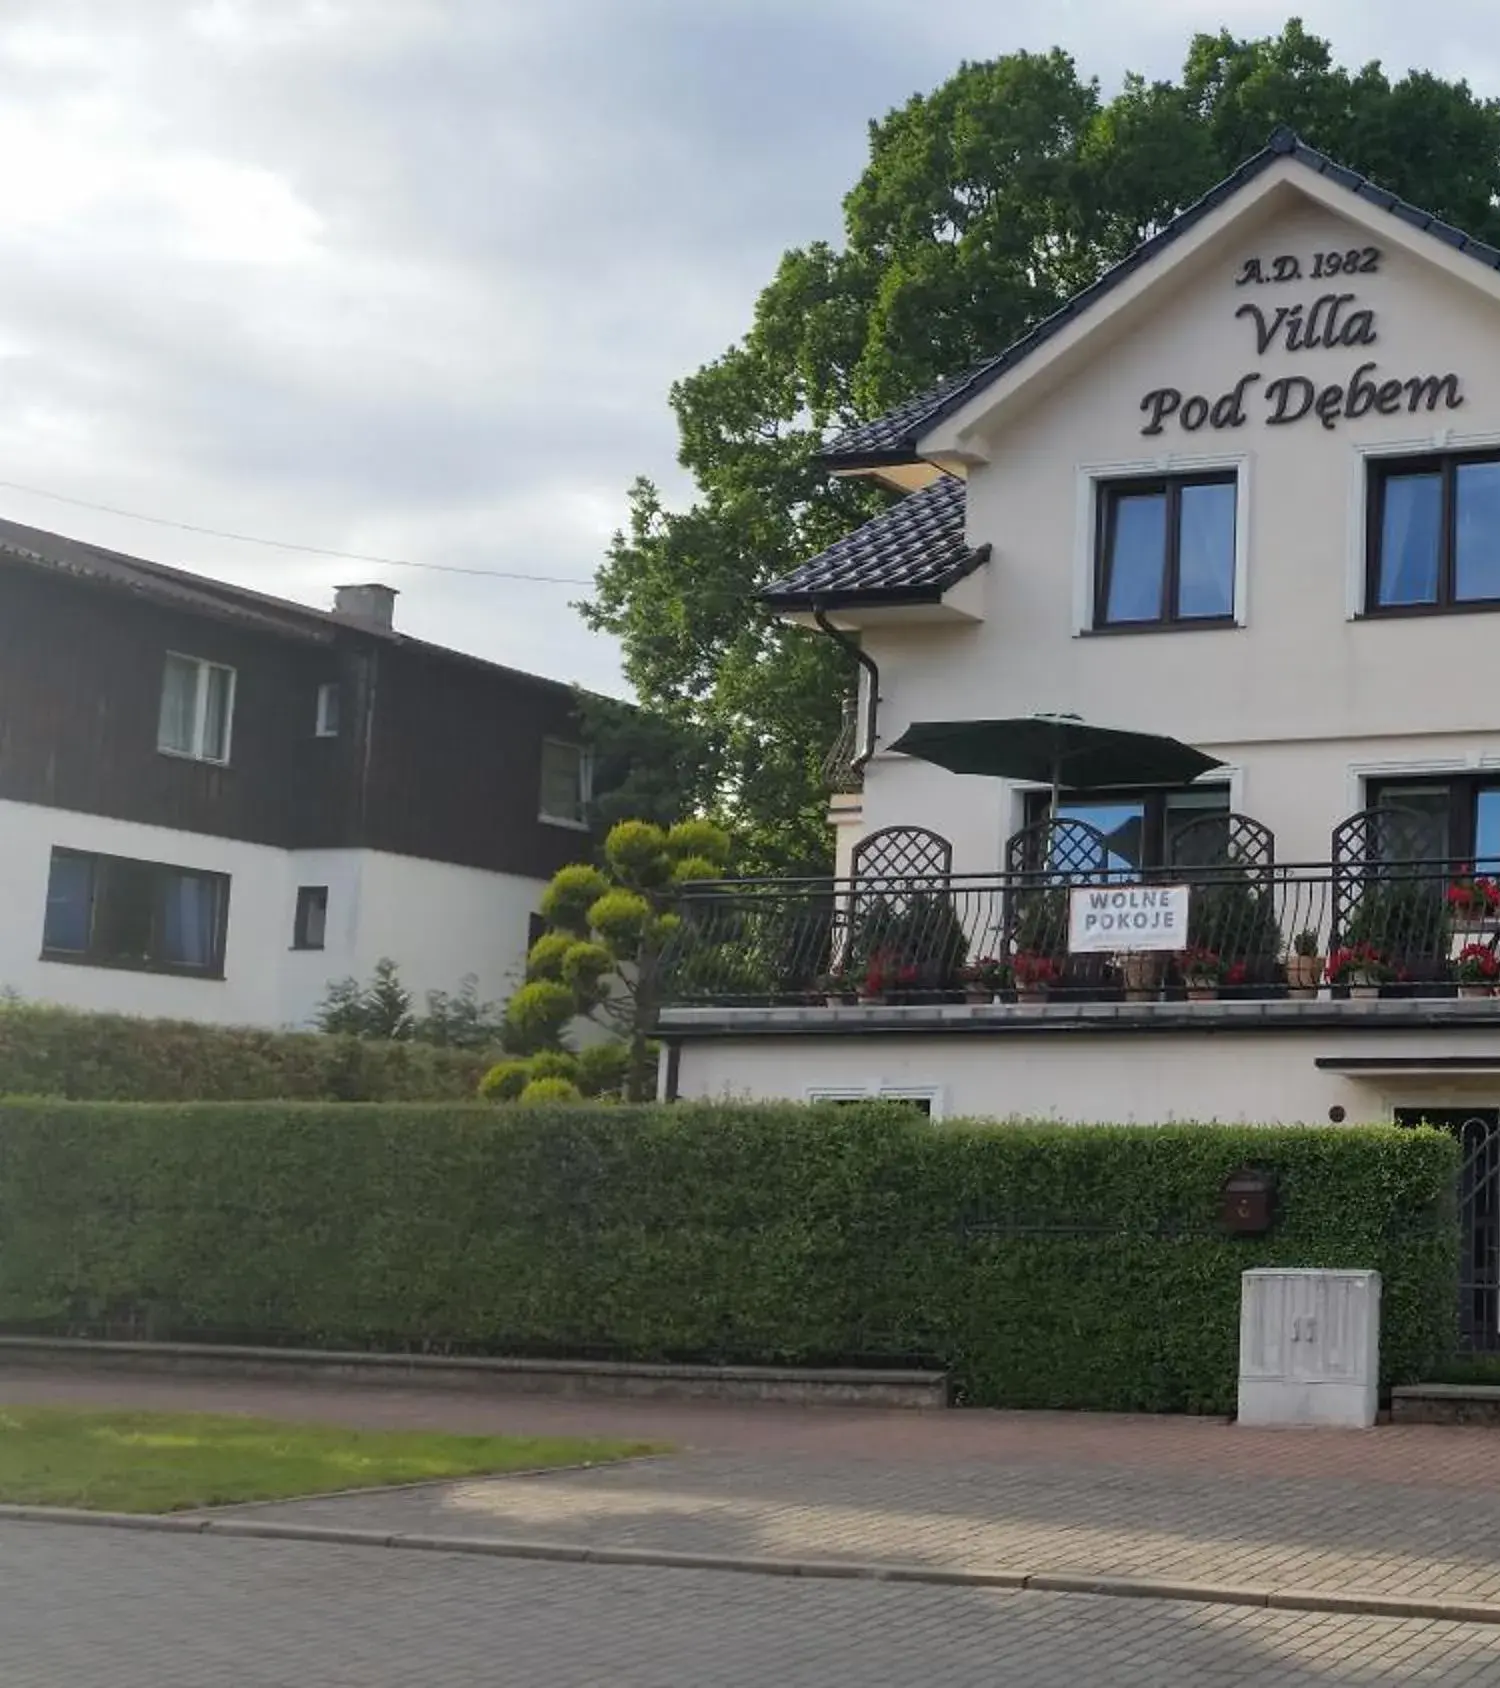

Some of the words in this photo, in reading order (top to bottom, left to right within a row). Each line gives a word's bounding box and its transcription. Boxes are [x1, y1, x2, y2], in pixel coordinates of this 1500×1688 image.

[1236, 255, 1301, 286] A.D.
[1309, 247, 1381, 279] 1982
[1235, 294, 1377, 355] Villa
[1140, 372, 1261, 435] Pod
[1264, 361, 1465, 429] Dębem
[1090, 891, 1170, 909] WOLNE
[1085, 912, 1174, 930] POKOJE
